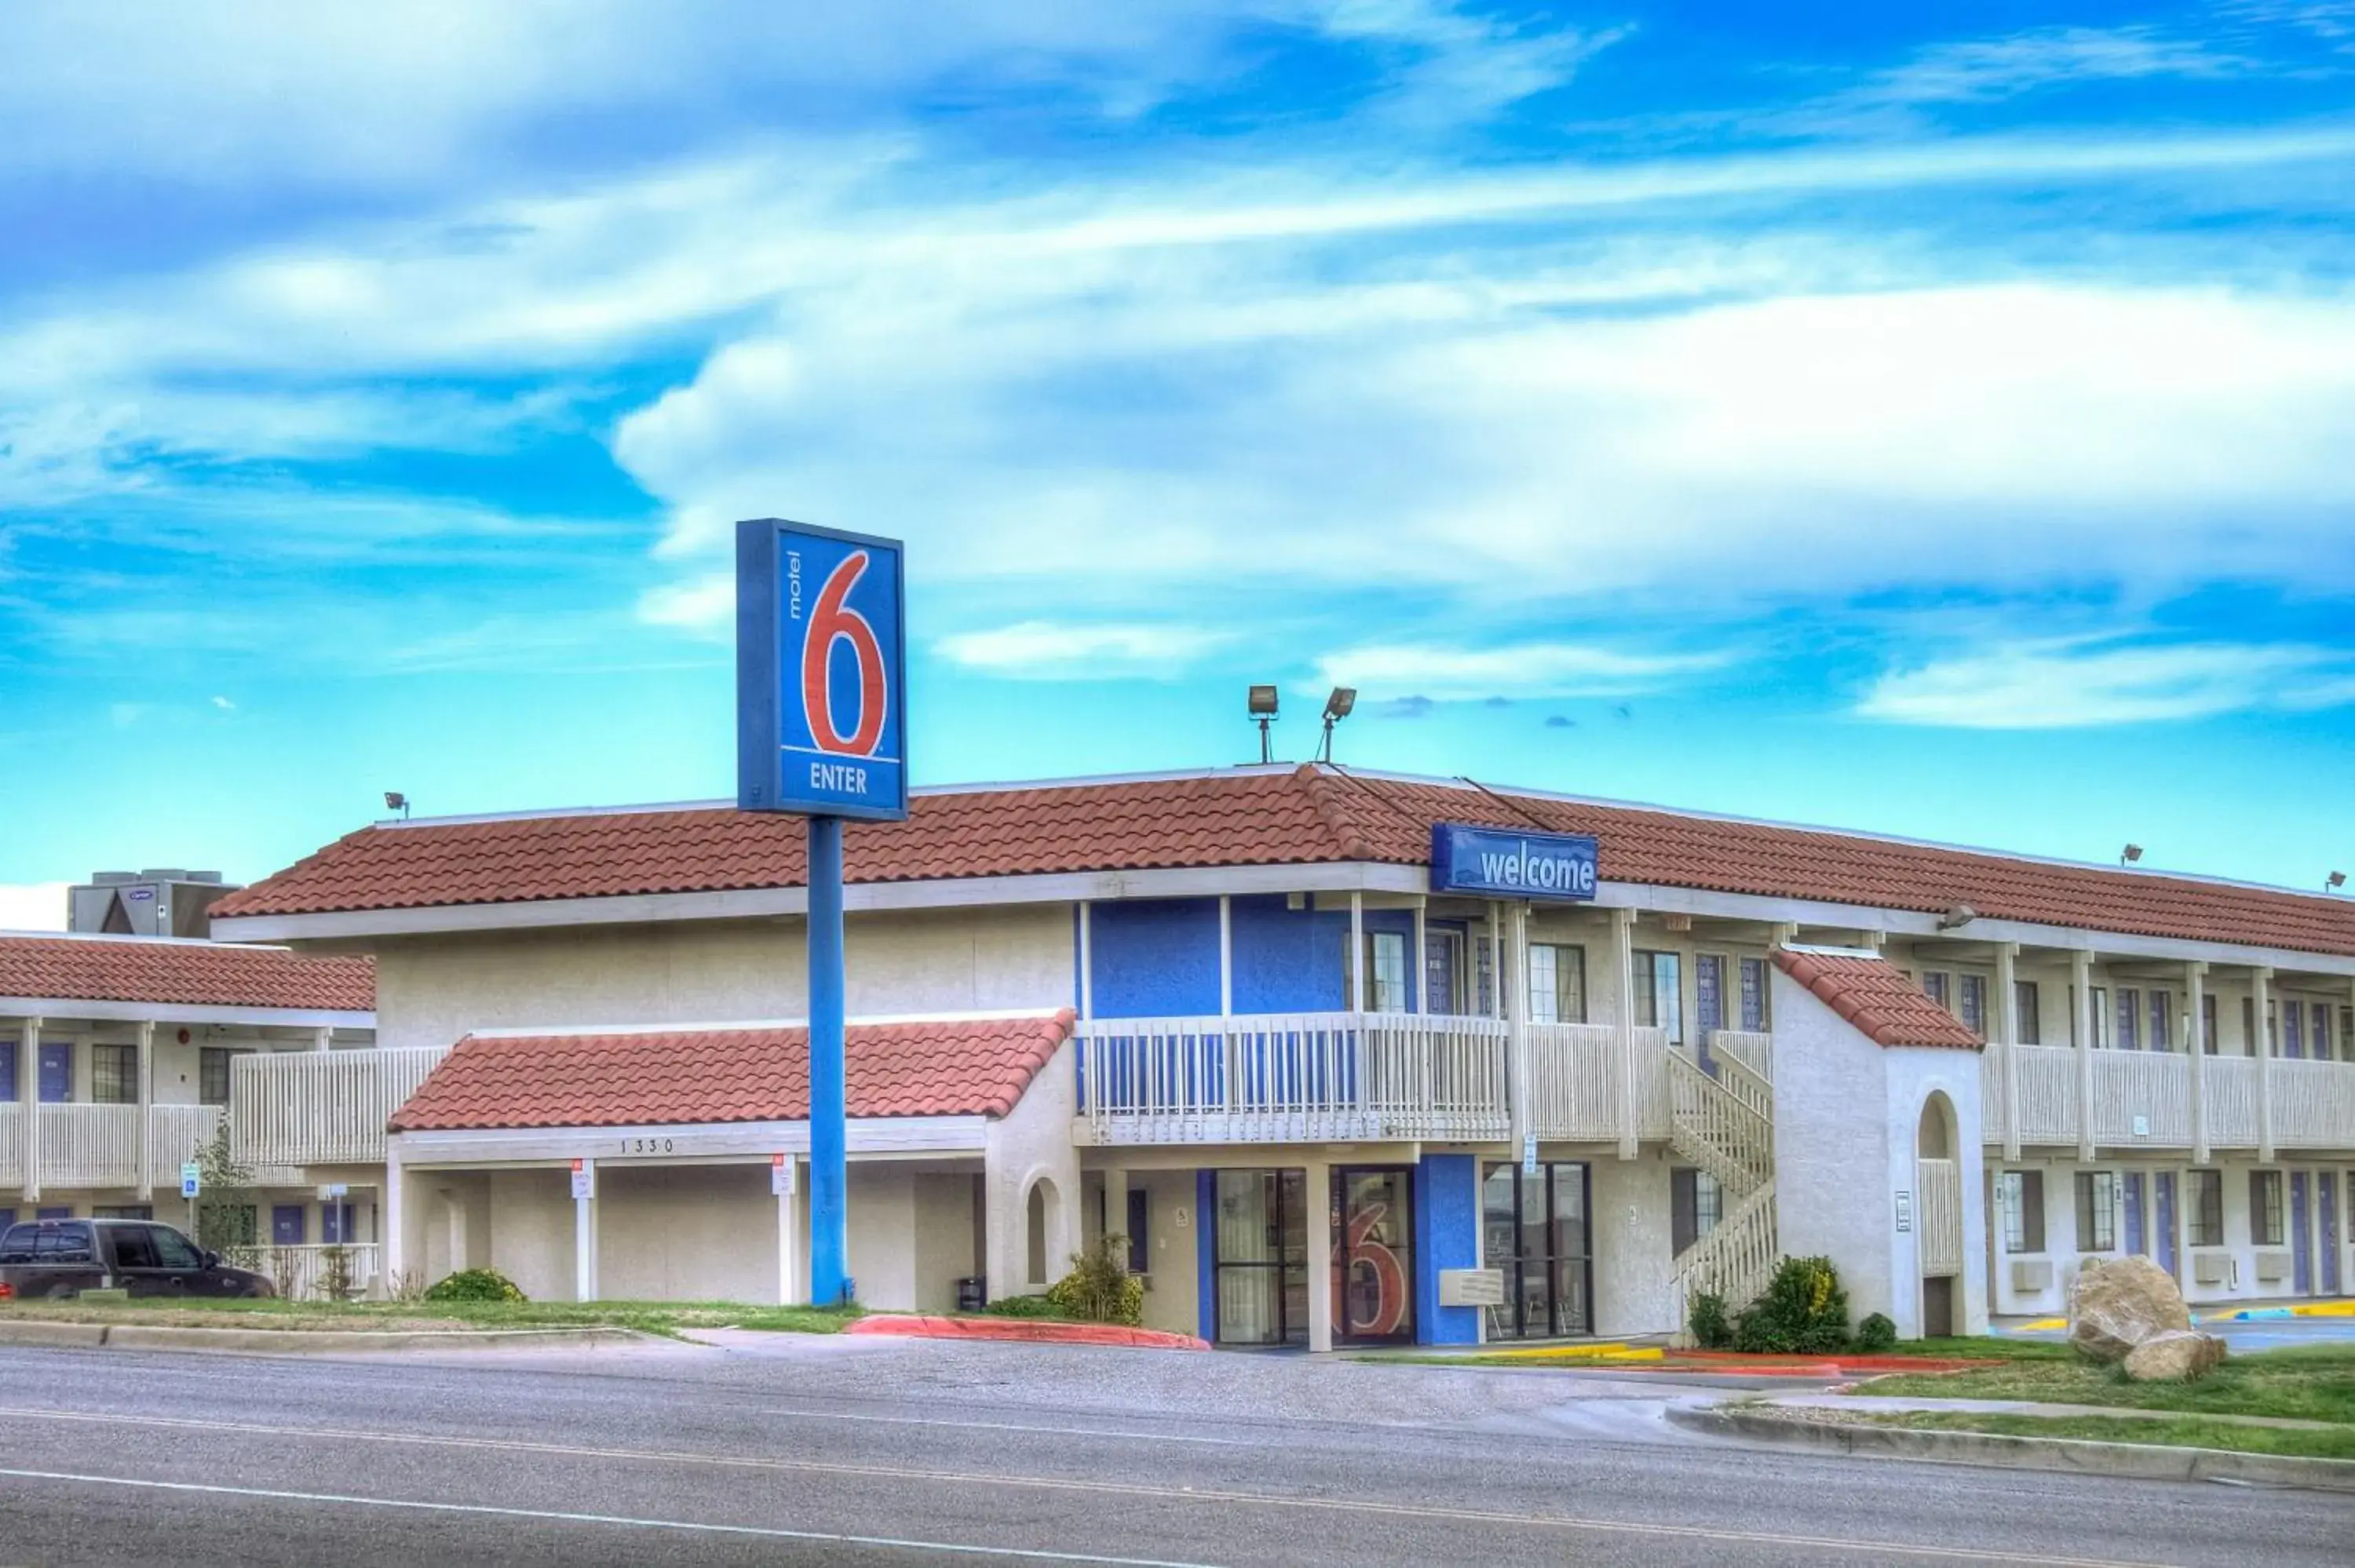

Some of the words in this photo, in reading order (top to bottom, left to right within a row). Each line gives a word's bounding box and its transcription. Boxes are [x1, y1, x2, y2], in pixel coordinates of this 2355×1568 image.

[787, 551, 801, 619] motel
[801, 549, 887, 758] 6
[811, 762, 867, 795] ENTER
[1481, 841, 1594, 891] welcome
[622, 1139, 673, 1154] 1330
